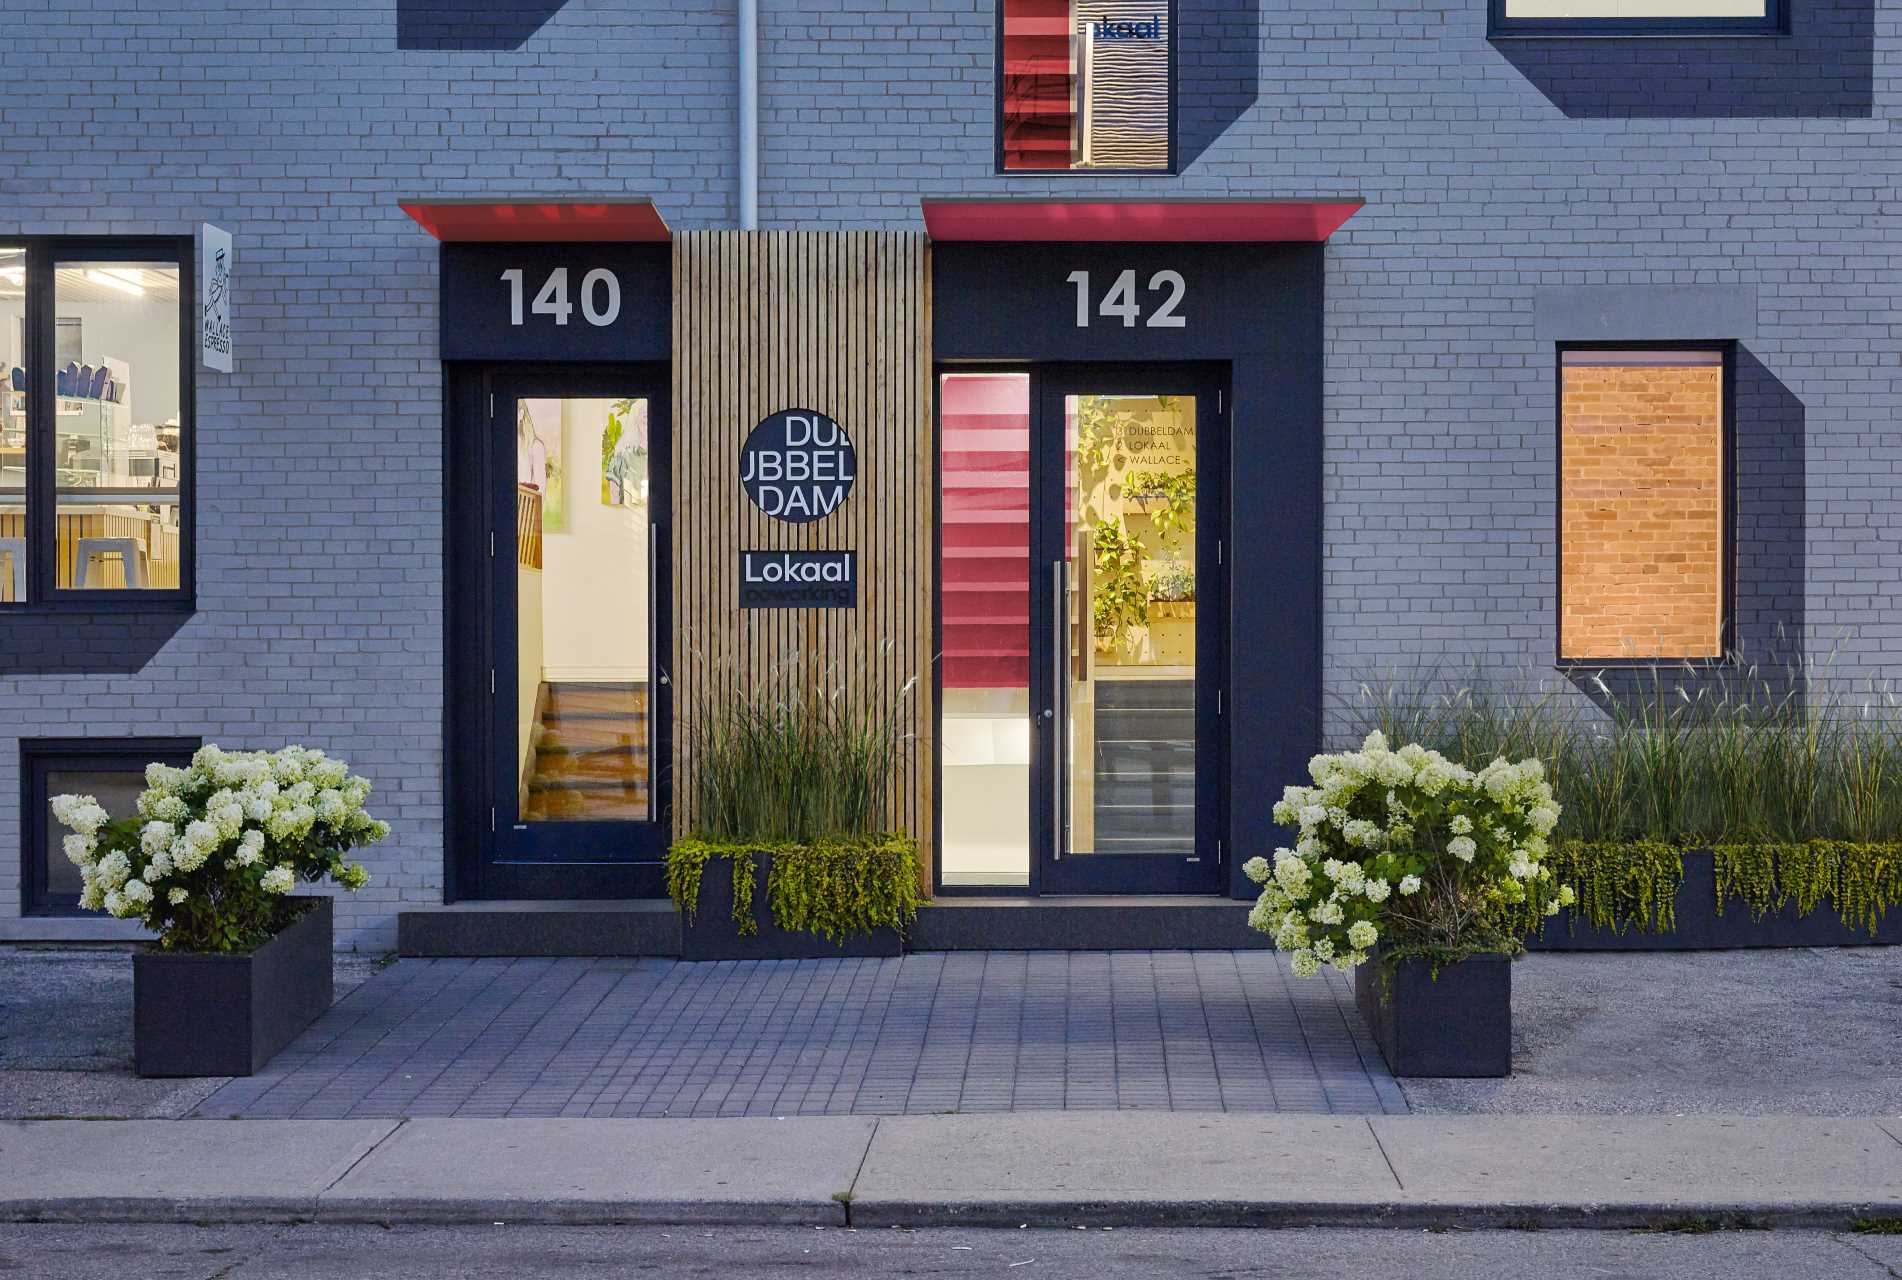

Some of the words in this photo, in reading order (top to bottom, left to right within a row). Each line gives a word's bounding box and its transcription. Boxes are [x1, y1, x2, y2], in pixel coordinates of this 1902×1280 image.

[500, 267, 621, 326] 140
[1066, 269, 1186, 327] 142
[205, 320, 229, 338] WALLACE
[205, 333, 230, 354] ESPRESSO
[1129, 426, 1194, 436] DUBBELDAM
[1129, 441, 1171, 450] LOKAAL
[1129, 456, 1181, 465] WALLACE
[759, 486, 843, 516] DAM
[745, 554, 850, 582] Lokaal
